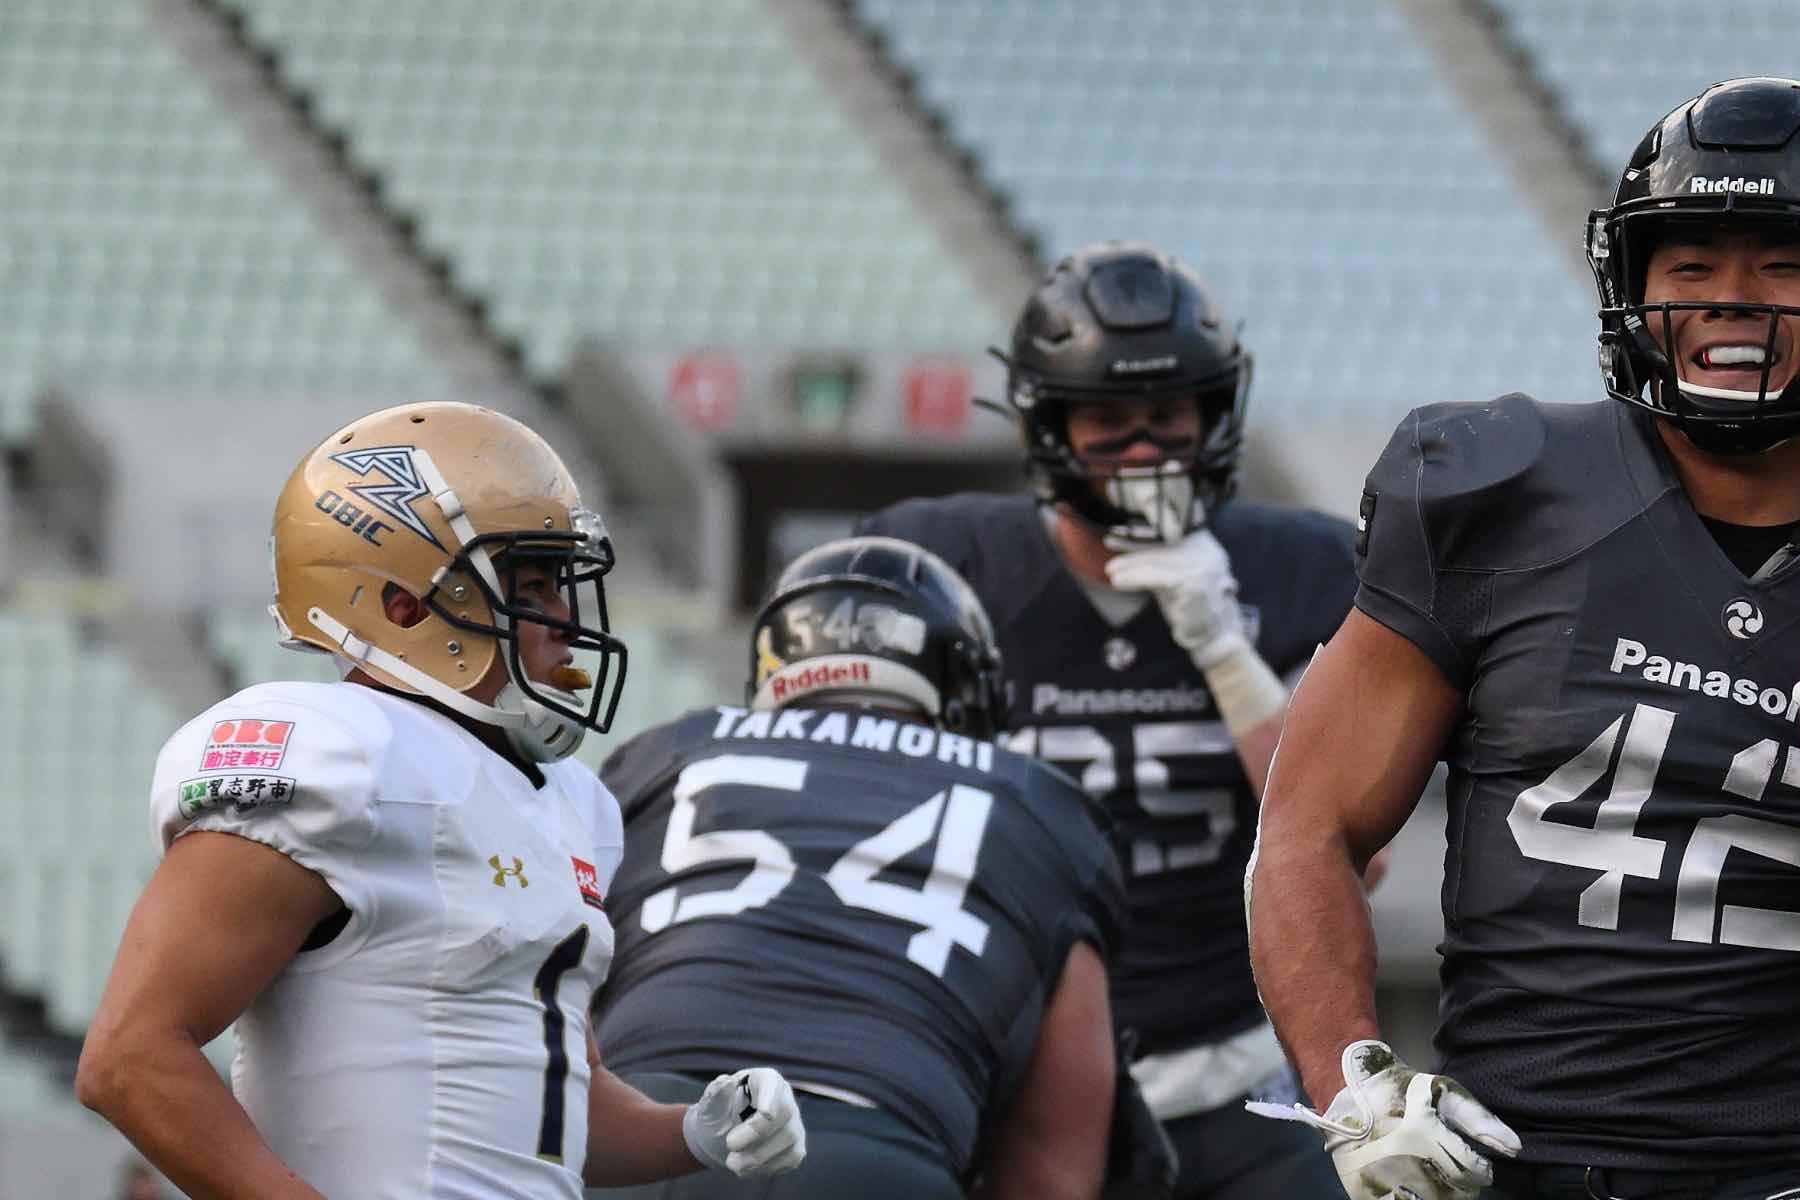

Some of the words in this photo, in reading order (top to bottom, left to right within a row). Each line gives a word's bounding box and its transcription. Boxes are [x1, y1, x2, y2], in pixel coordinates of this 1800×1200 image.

[1690, 175, 1777, 195] Riddell
[313, 489, 396, 547] OBIC
[771, 661, 872, 699] Riddell
[212, 719, 290, 744] OBC
[711, 705, 994, 772] TAKAMORI
[207, 777, 290, 800] 習志野市
[640, 754, 994, 978] 54
[534, 921, 591, 1167] 1
